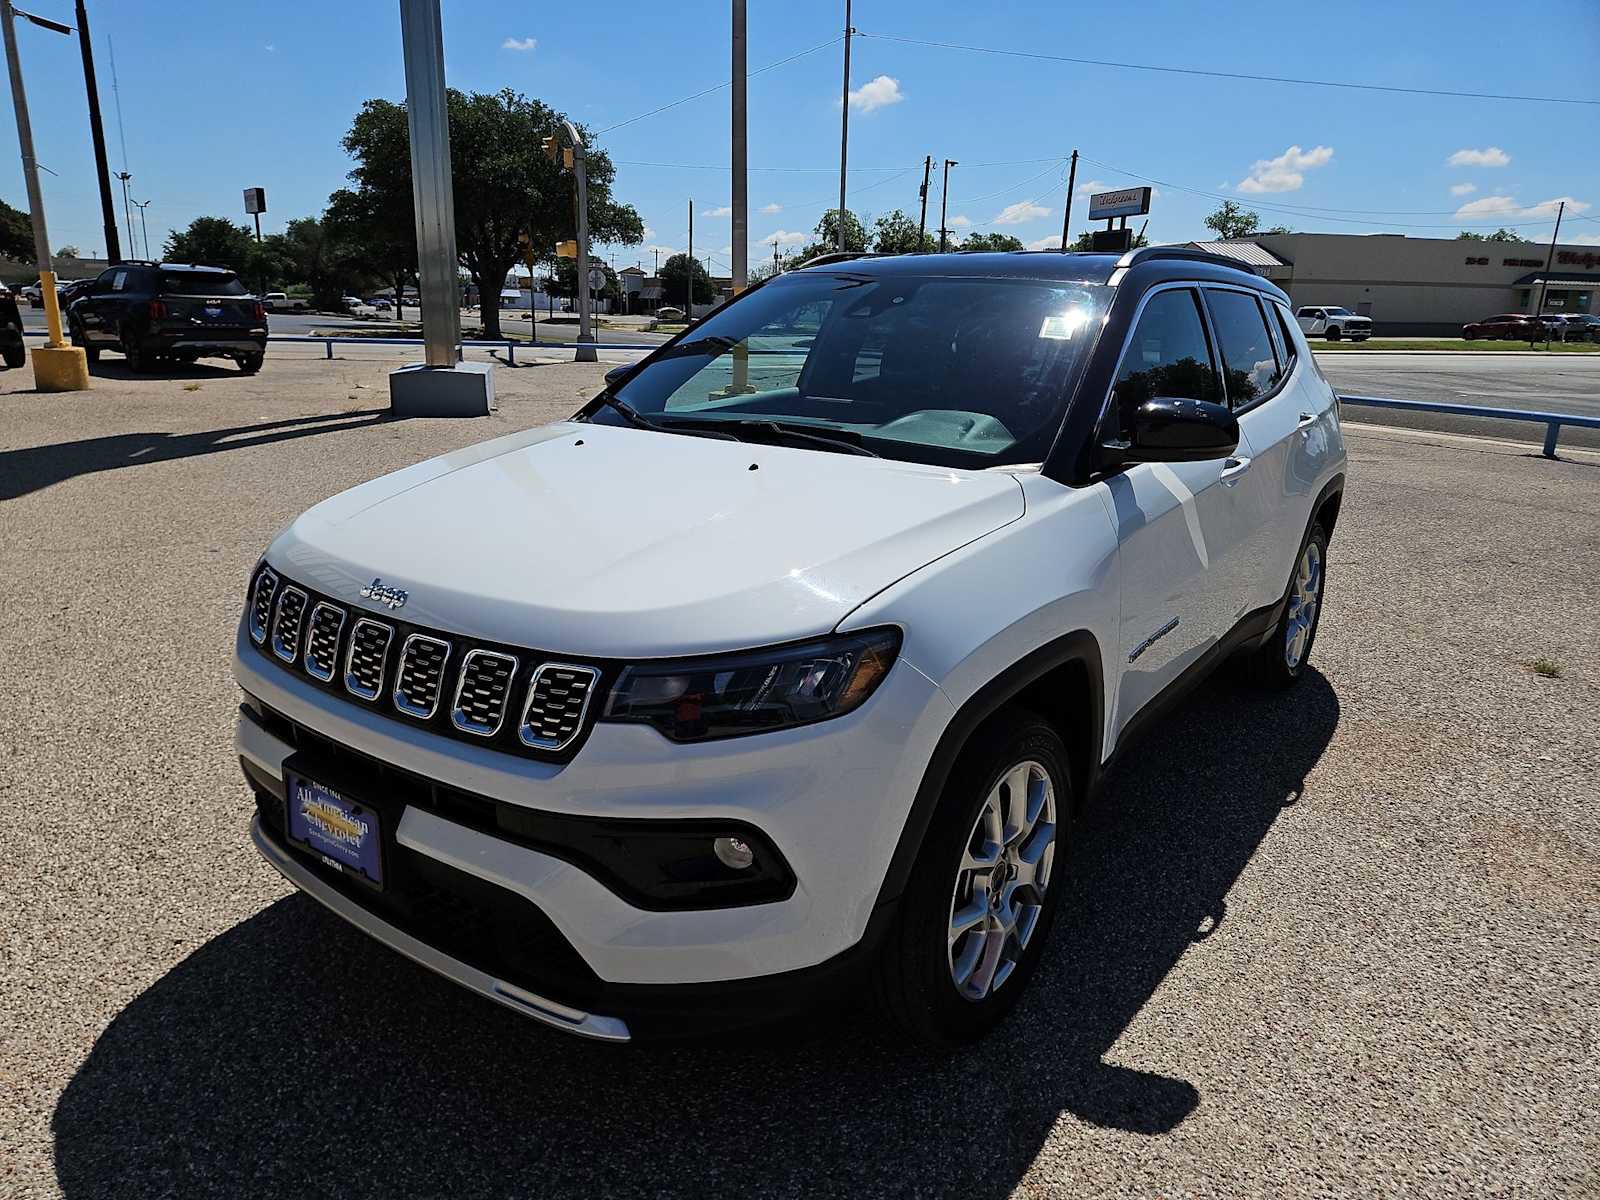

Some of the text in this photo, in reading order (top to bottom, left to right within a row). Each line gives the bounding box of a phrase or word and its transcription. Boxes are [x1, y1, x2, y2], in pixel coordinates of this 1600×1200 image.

[359, 577, 408, 610] Jeep
[296, 787, 369, 834] All American
[303, 810, 361, 848] Chevrolet
